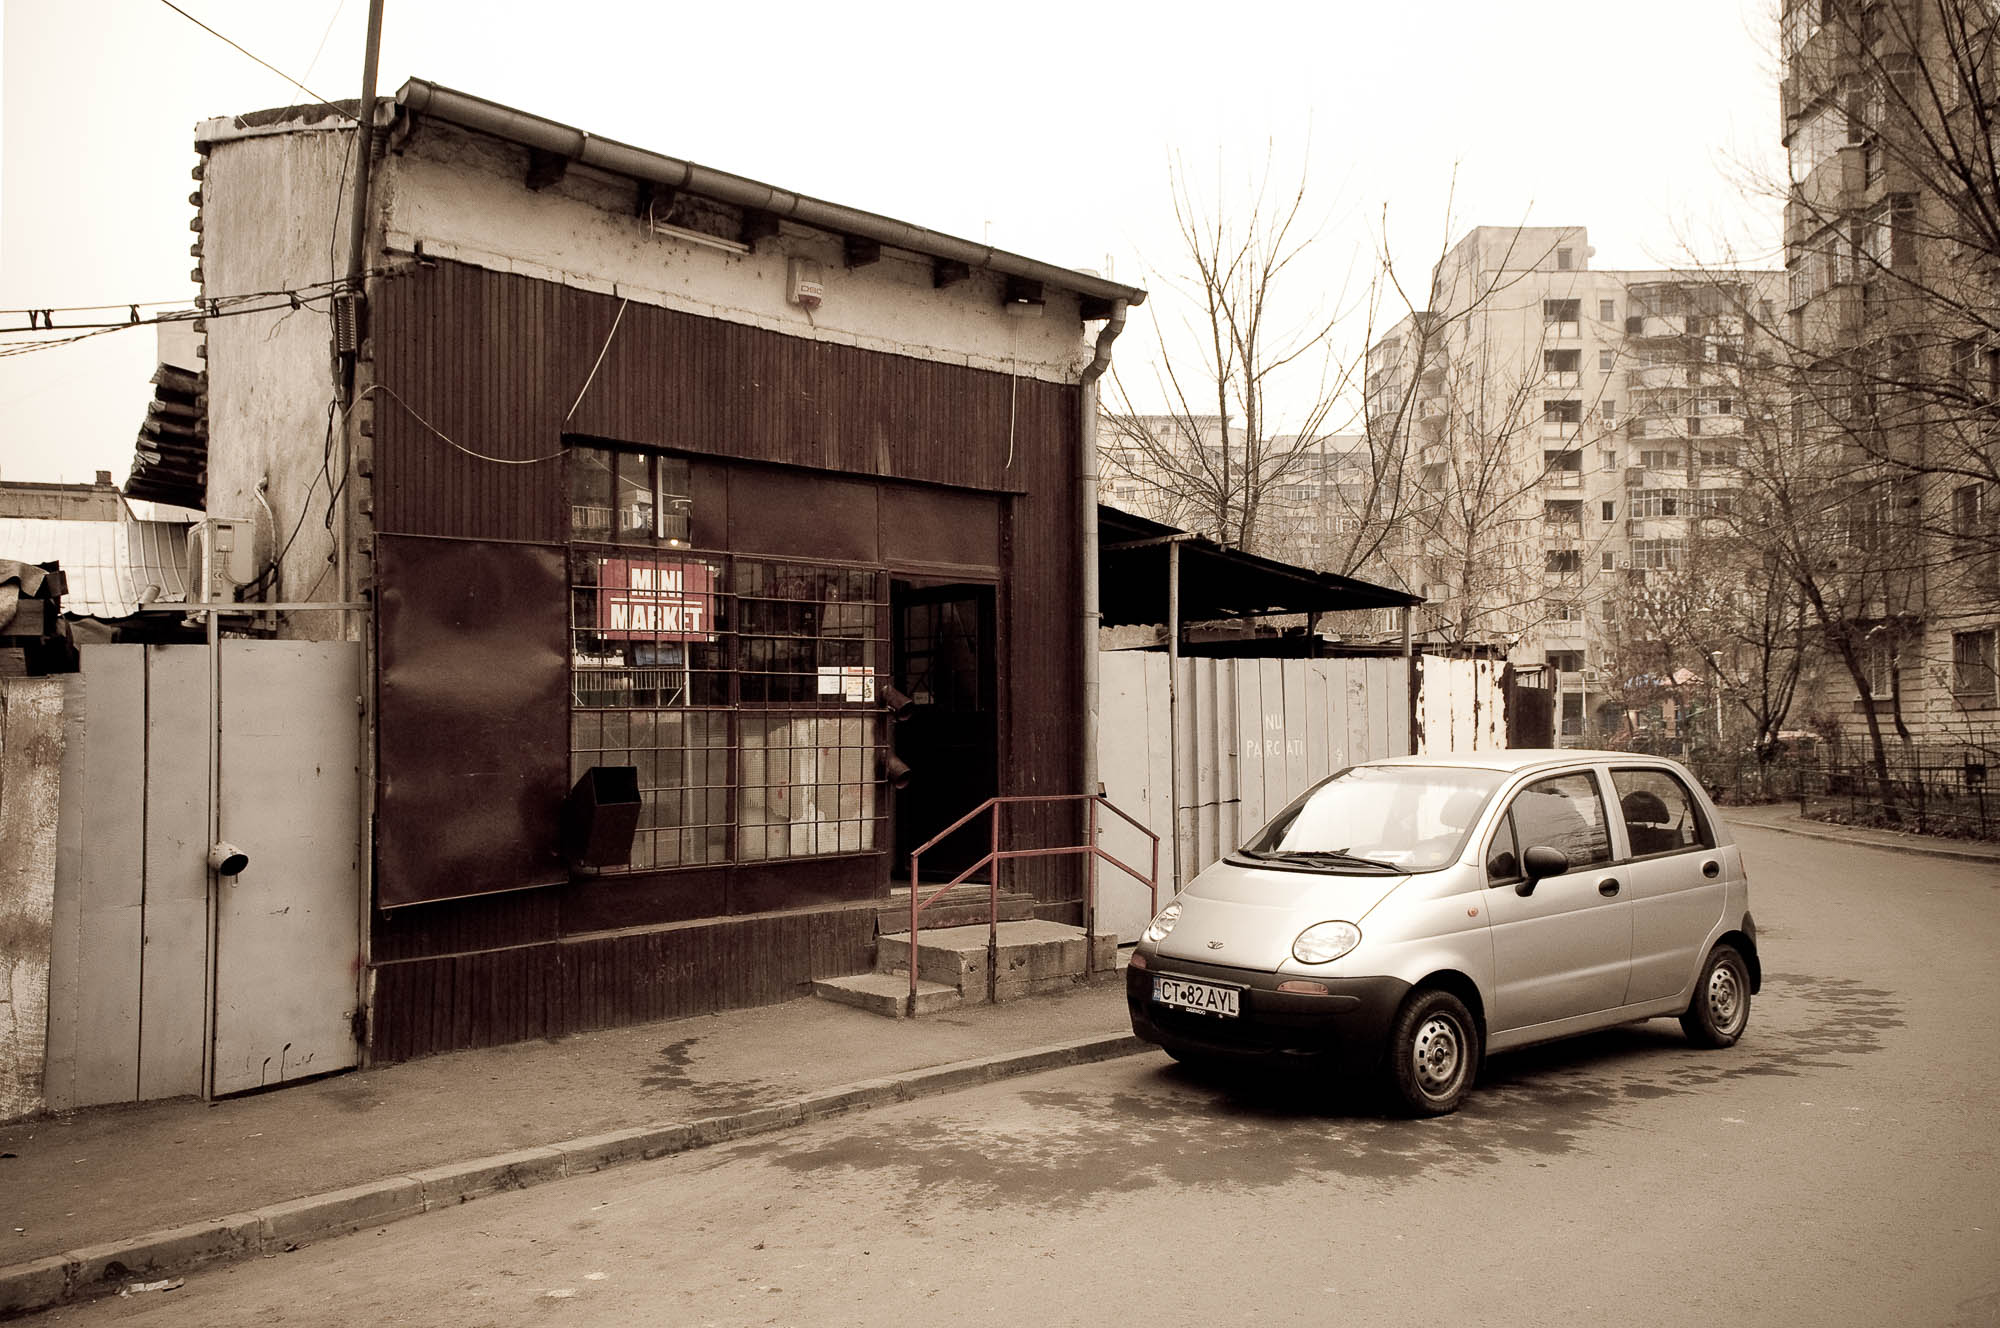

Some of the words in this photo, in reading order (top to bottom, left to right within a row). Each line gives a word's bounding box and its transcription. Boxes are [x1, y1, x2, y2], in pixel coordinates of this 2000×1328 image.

[631, 568, 682, 598] MINI
[610, 603, 703, 635] MARKET
[1265, 714, 1282, 731] NU
